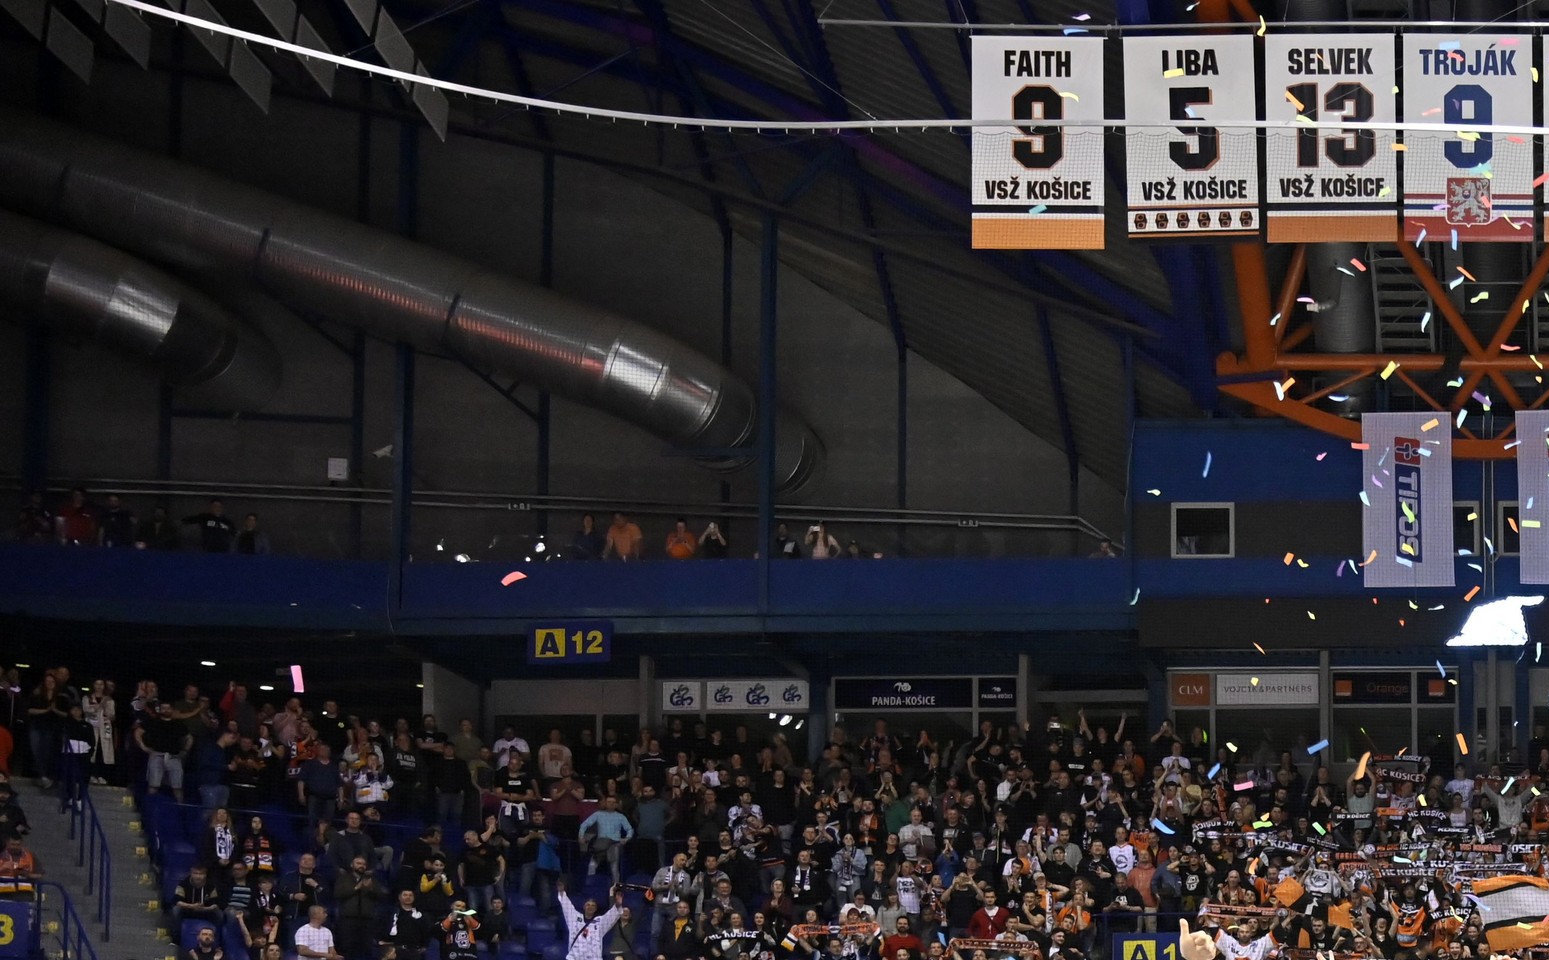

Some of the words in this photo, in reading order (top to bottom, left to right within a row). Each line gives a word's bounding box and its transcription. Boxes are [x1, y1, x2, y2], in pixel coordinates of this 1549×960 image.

[1004, 50, 1072, 77] FAITH
[1162, 49, 1219, 76] LIBA
[1288, 48, 1373, 75] SELVEK
[1419, 43, 1516, 76] TROJÁK
[1012, 84, 1064, 170] 9
[1169, 87, 1220, 171] 5
[1286, 82, 1375, 168] 13
[1444, 84, 1493, 169] 9
[985, 175, 1020, 200] VSŽ
[1026, 174, 1092, 200] KOŠICE
[1142, 177, 1175, 201] VSŽ
[1183, 175, 1247, 199] KOŠICE
[1280, 173, 1314, 198] VSŽ
[1321, 172, 1386, 197] KOŠICE
[1398, 471, 1419, 556] TIPOS
[539, 631, 561, 655] A
[571, 630, 603, 655] 12
[872, 694, 936, 706] PANDA-KOŠICE
[1179, 685, 1203, 695] CLM
[1367, 681, 1409, 697] Orange
